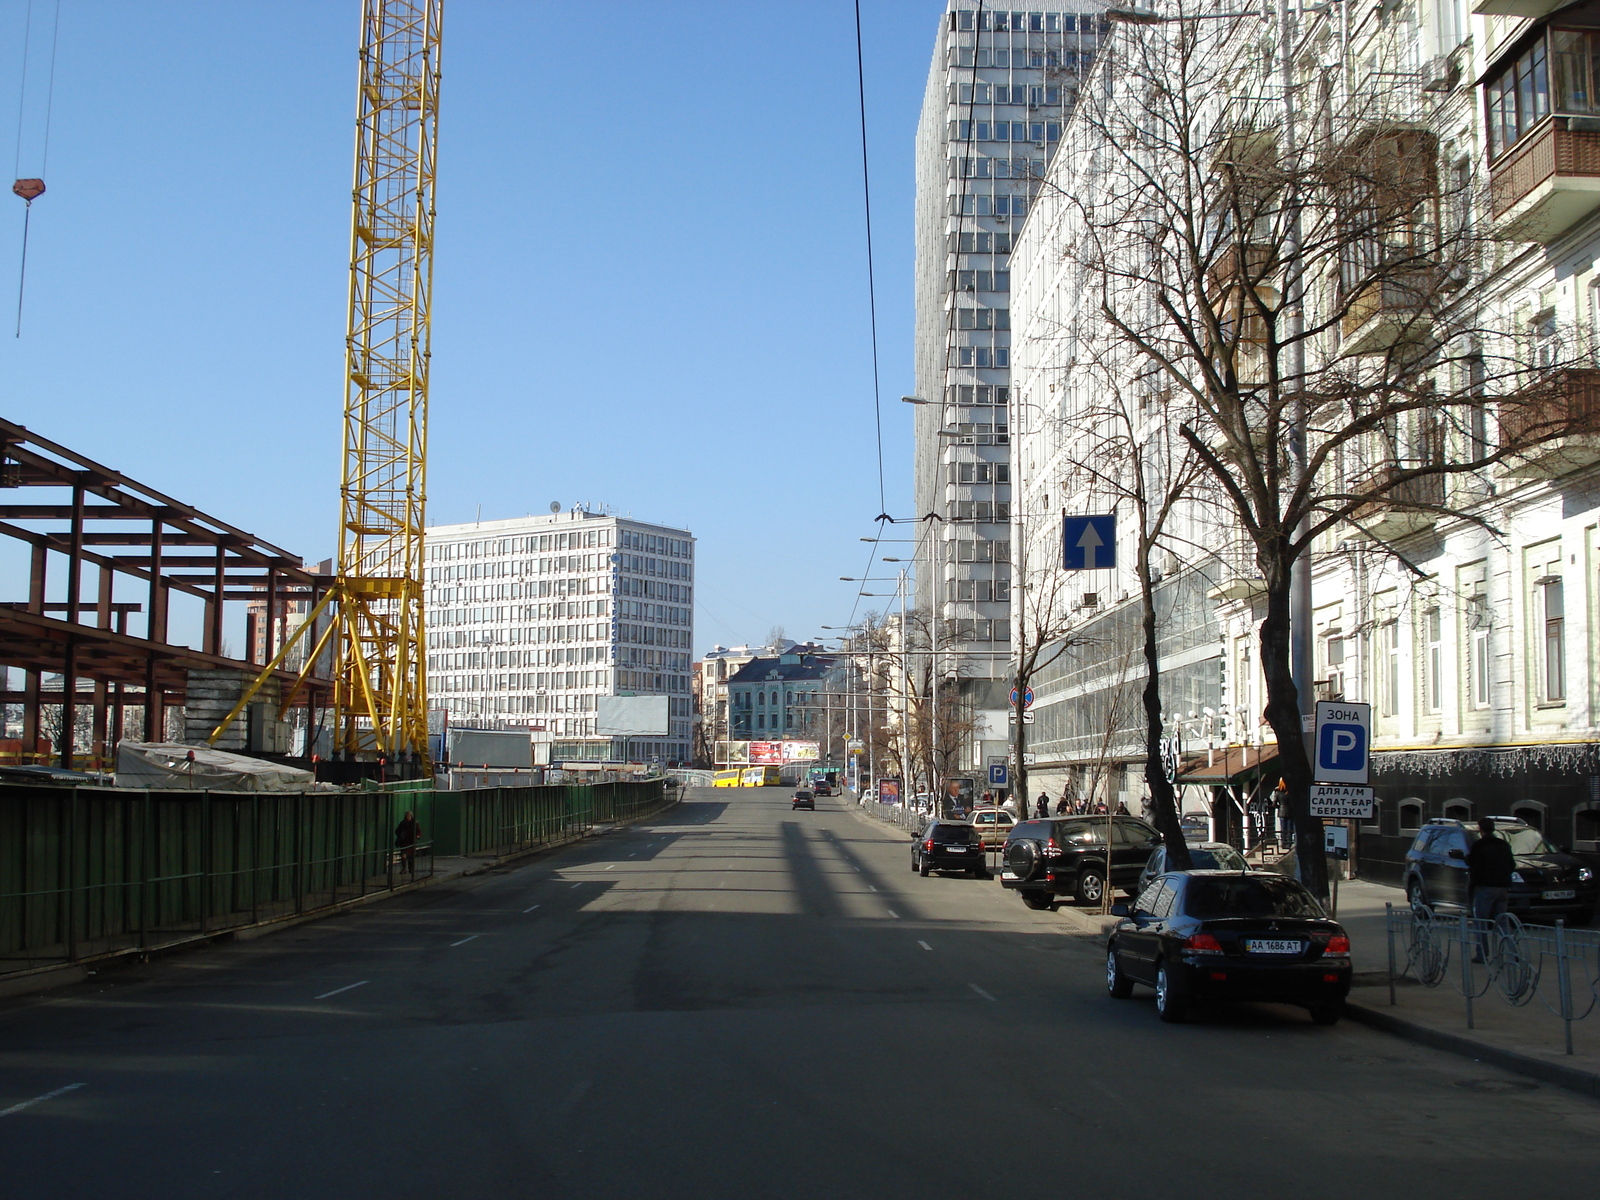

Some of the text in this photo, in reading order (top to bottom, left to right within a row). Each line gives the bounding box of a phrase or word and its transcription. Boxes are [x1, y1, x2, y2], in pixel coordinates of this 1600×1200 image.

[1326, 709, 1360, 721] ЗОНА
[1331, 730, 1357, 764] P
[993, 767, 1003, 781] P
[1317, 787, 1364, 797] ДЛЯ А/М
[1311, 797, 1372, 807] САЛАТ-БАР
[1265, 941, 1285, 950] 1686
